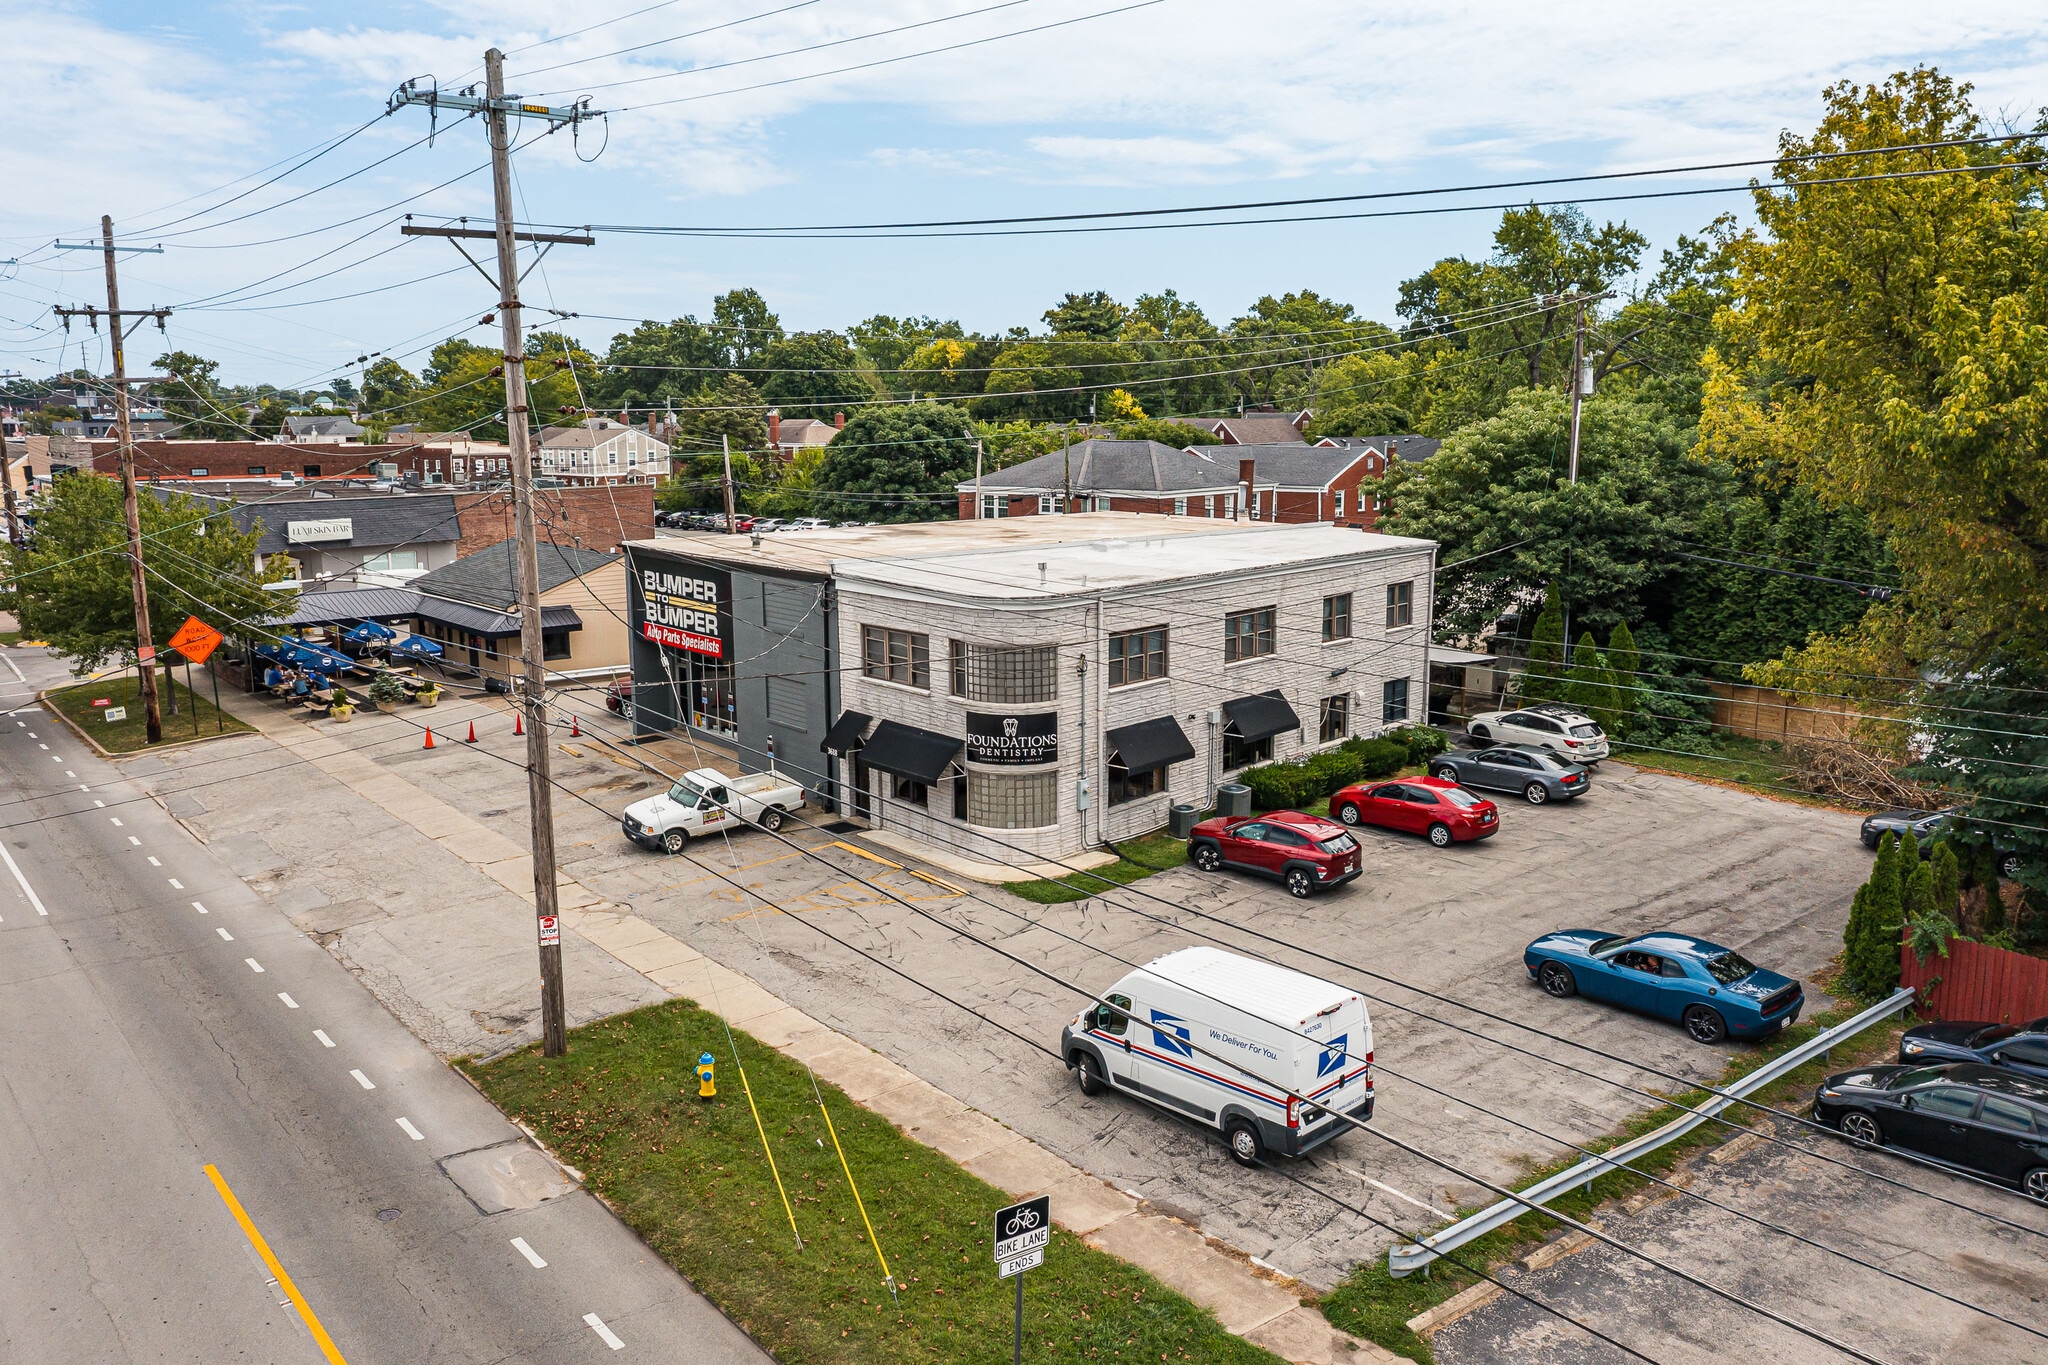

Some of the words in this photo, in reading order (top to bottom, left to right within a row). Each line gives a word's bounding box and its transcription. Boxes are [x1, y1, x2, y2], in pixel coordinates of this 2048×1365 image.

[644, 570, 717, 602] BUMPER
[656, 594, 668, 604] TO
[646, 602, 718, 636] BUMPER
[647, 626, 662, 640] Auto
[662, 628, 680, 644] Parts
[682, 634, 720, 654] Specialists
[967, 733, 1057, 748] FOUNDATIONS
[980, 747, 1044, 756] DENTISTRY
[1209, 1029, 1221, 1040] We
[1222, 1034, 1248, 1049] Deliver
[1248, 1043, 1262, 1054] For
[1262, 1048, 1278, 1060] You.
[998, 1240, 1018, 1256] BIKE
[1021, 1230, 1046, 1248] LANE
[1009, 1255, 1034, 1272] ENDS
